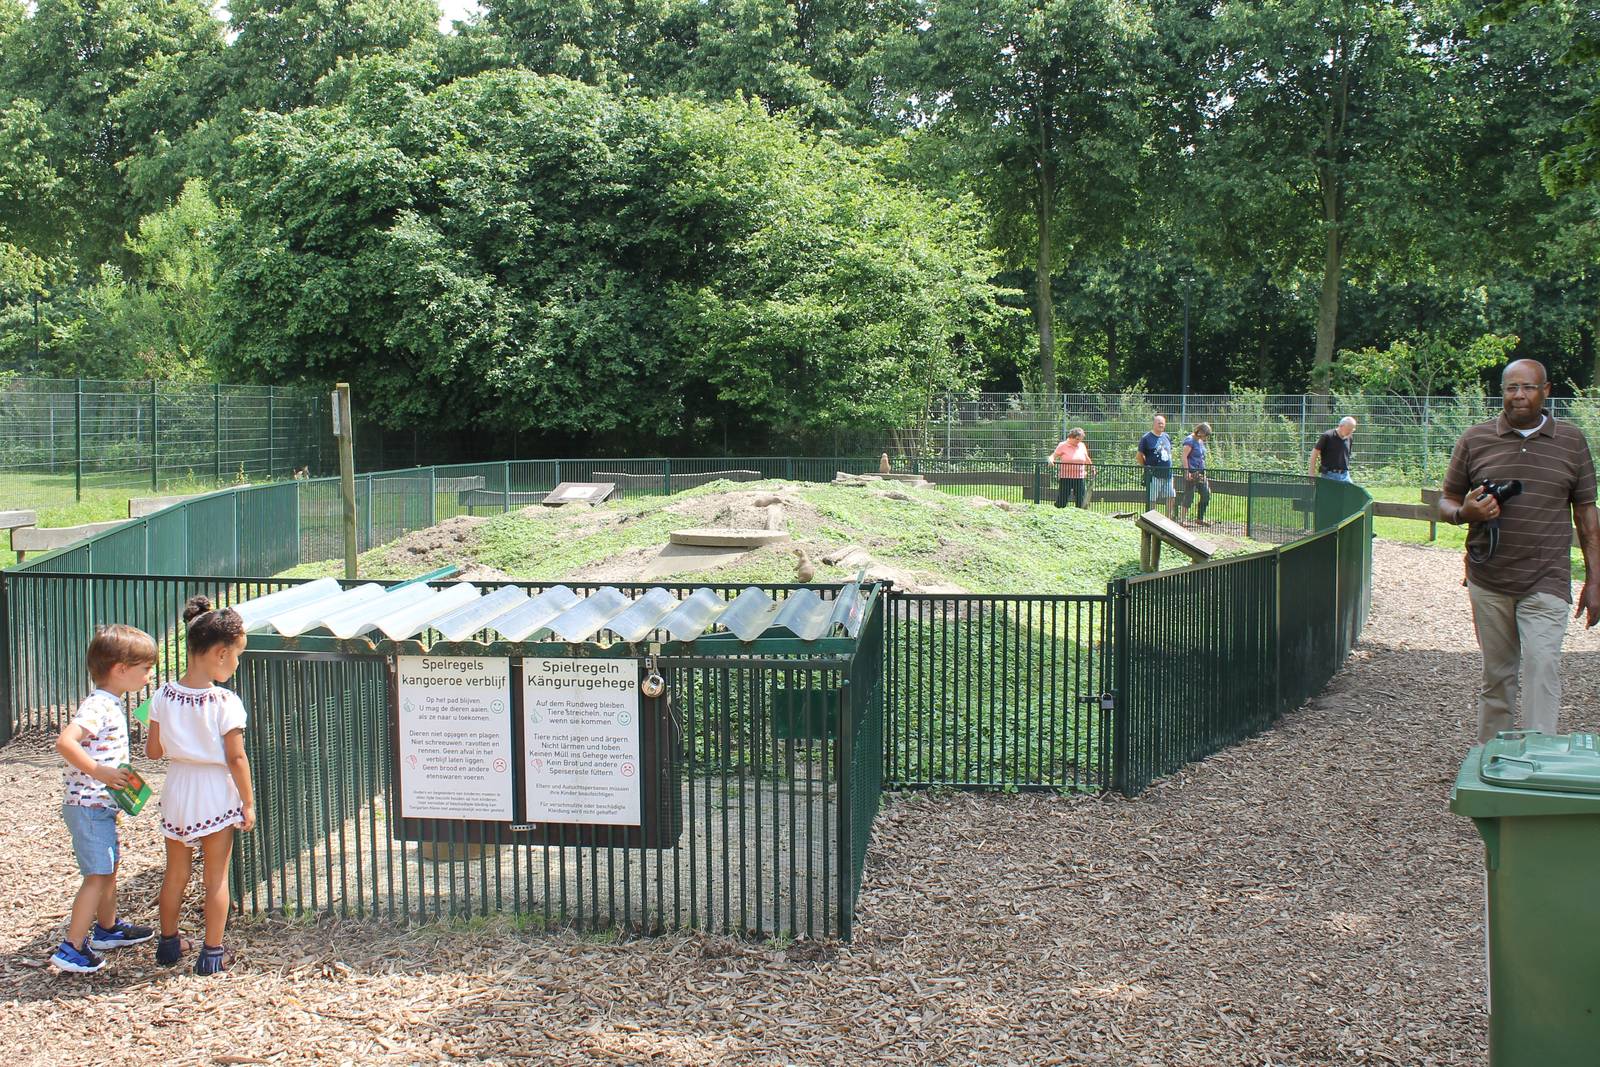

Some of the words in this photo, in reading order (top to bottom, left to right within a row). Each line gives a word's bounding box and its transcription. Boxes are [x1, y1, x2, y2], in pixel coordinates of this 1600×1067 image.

[422, 659, 484, 672] Spelregels
[542, 661, 619, 675] Spielregeln
[402, 675, 462, 688] kangoeroe
[466, 676, 506, 689] verblijf
[528, 675, 635, 691] Kängurugehege
[566, 700, 598, 709] Rundweg
[582, 752, 608, 761] Gehege
